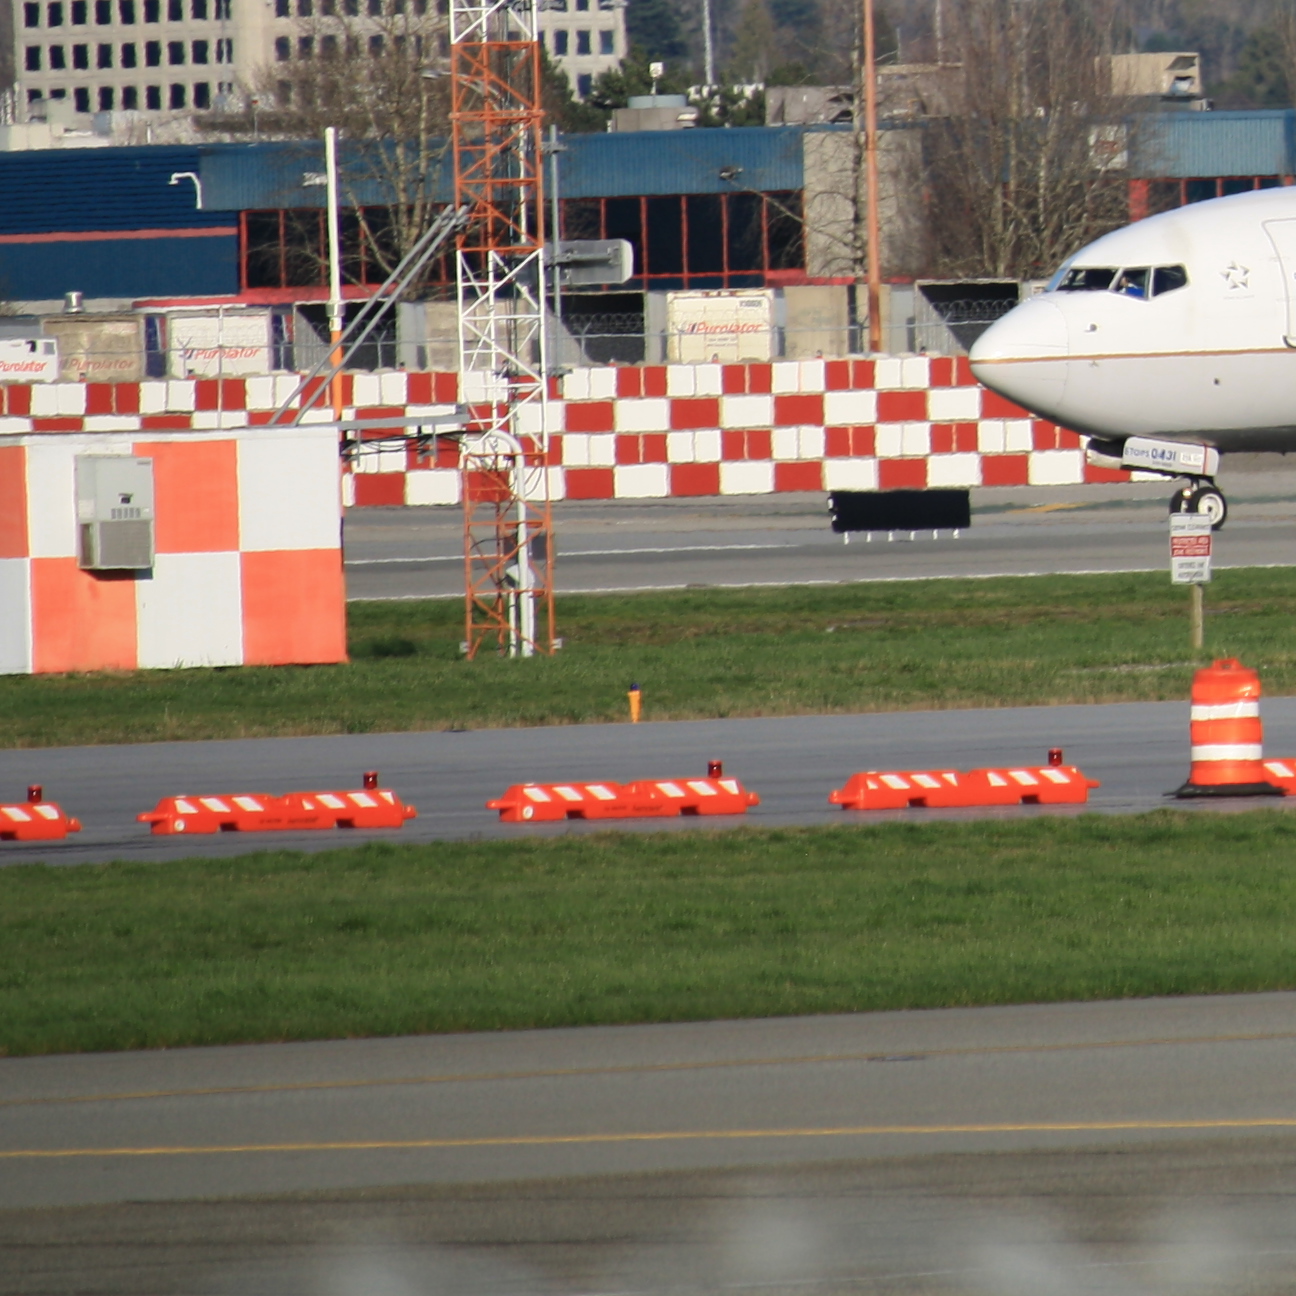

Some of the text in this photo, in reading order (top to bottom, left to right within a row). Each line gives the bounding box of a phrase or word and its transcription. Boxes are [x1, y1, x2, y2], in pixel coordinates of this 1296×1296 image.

[694, 320, 765, 334] Purolator
[193, 346, 262, 360] Purolator
[69, 358, 134, 372] Purolator
[1151, 448, 1177, 461] 0431
